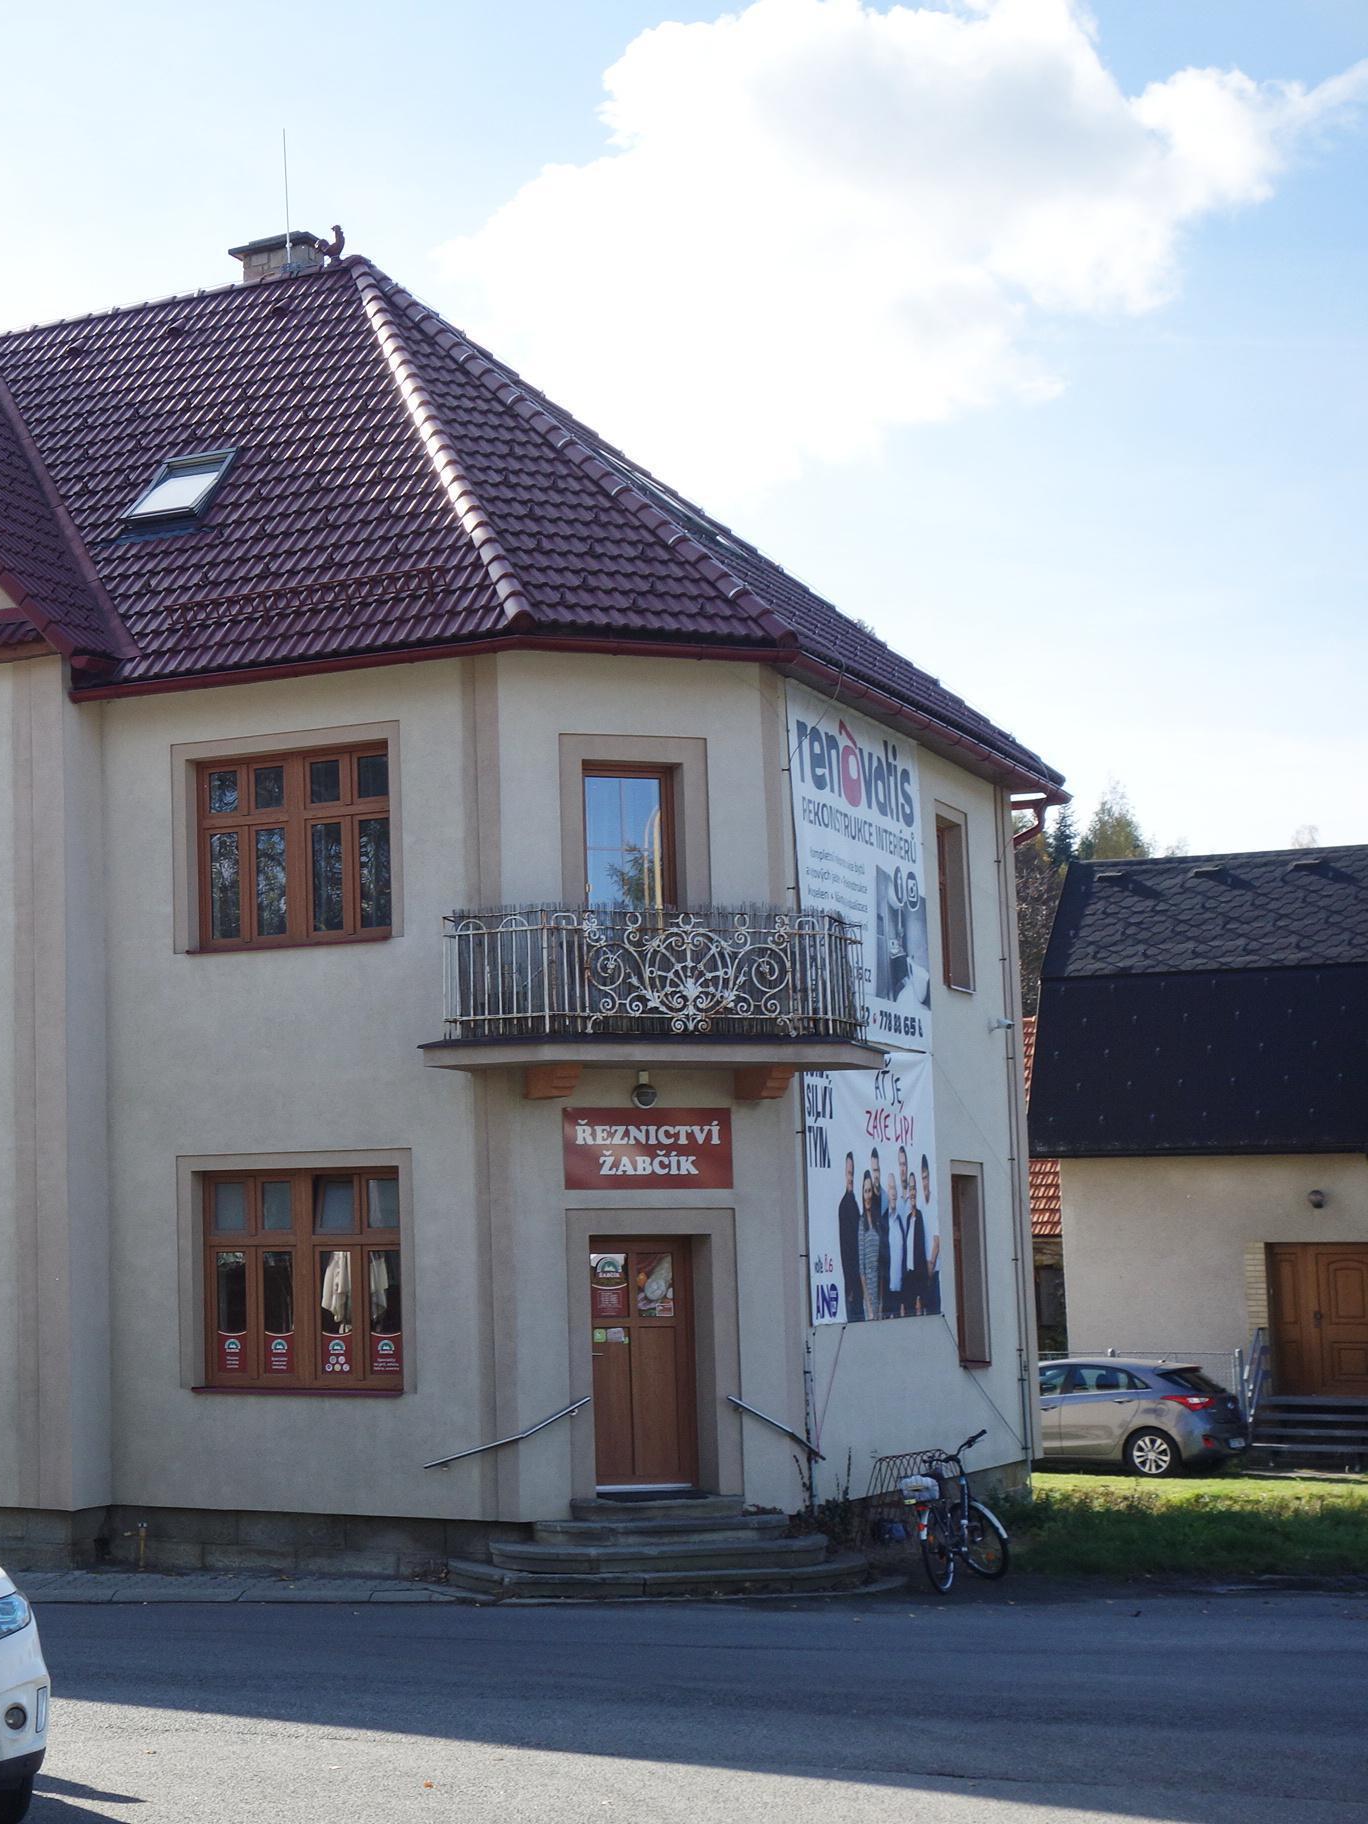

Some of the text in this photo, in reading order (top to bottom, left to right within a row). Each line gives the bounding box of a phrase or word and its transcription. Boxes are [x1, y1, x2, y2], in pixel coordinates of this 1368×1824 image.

[575, 1119, 720, 1145] ŘEZNICTVÍ
[865, 1101, 915, 1147] ZASE LÍP!
[599, 1150, 699, 1175] ŽABČÍK
[816, 1283, 839, 1320] ANO
